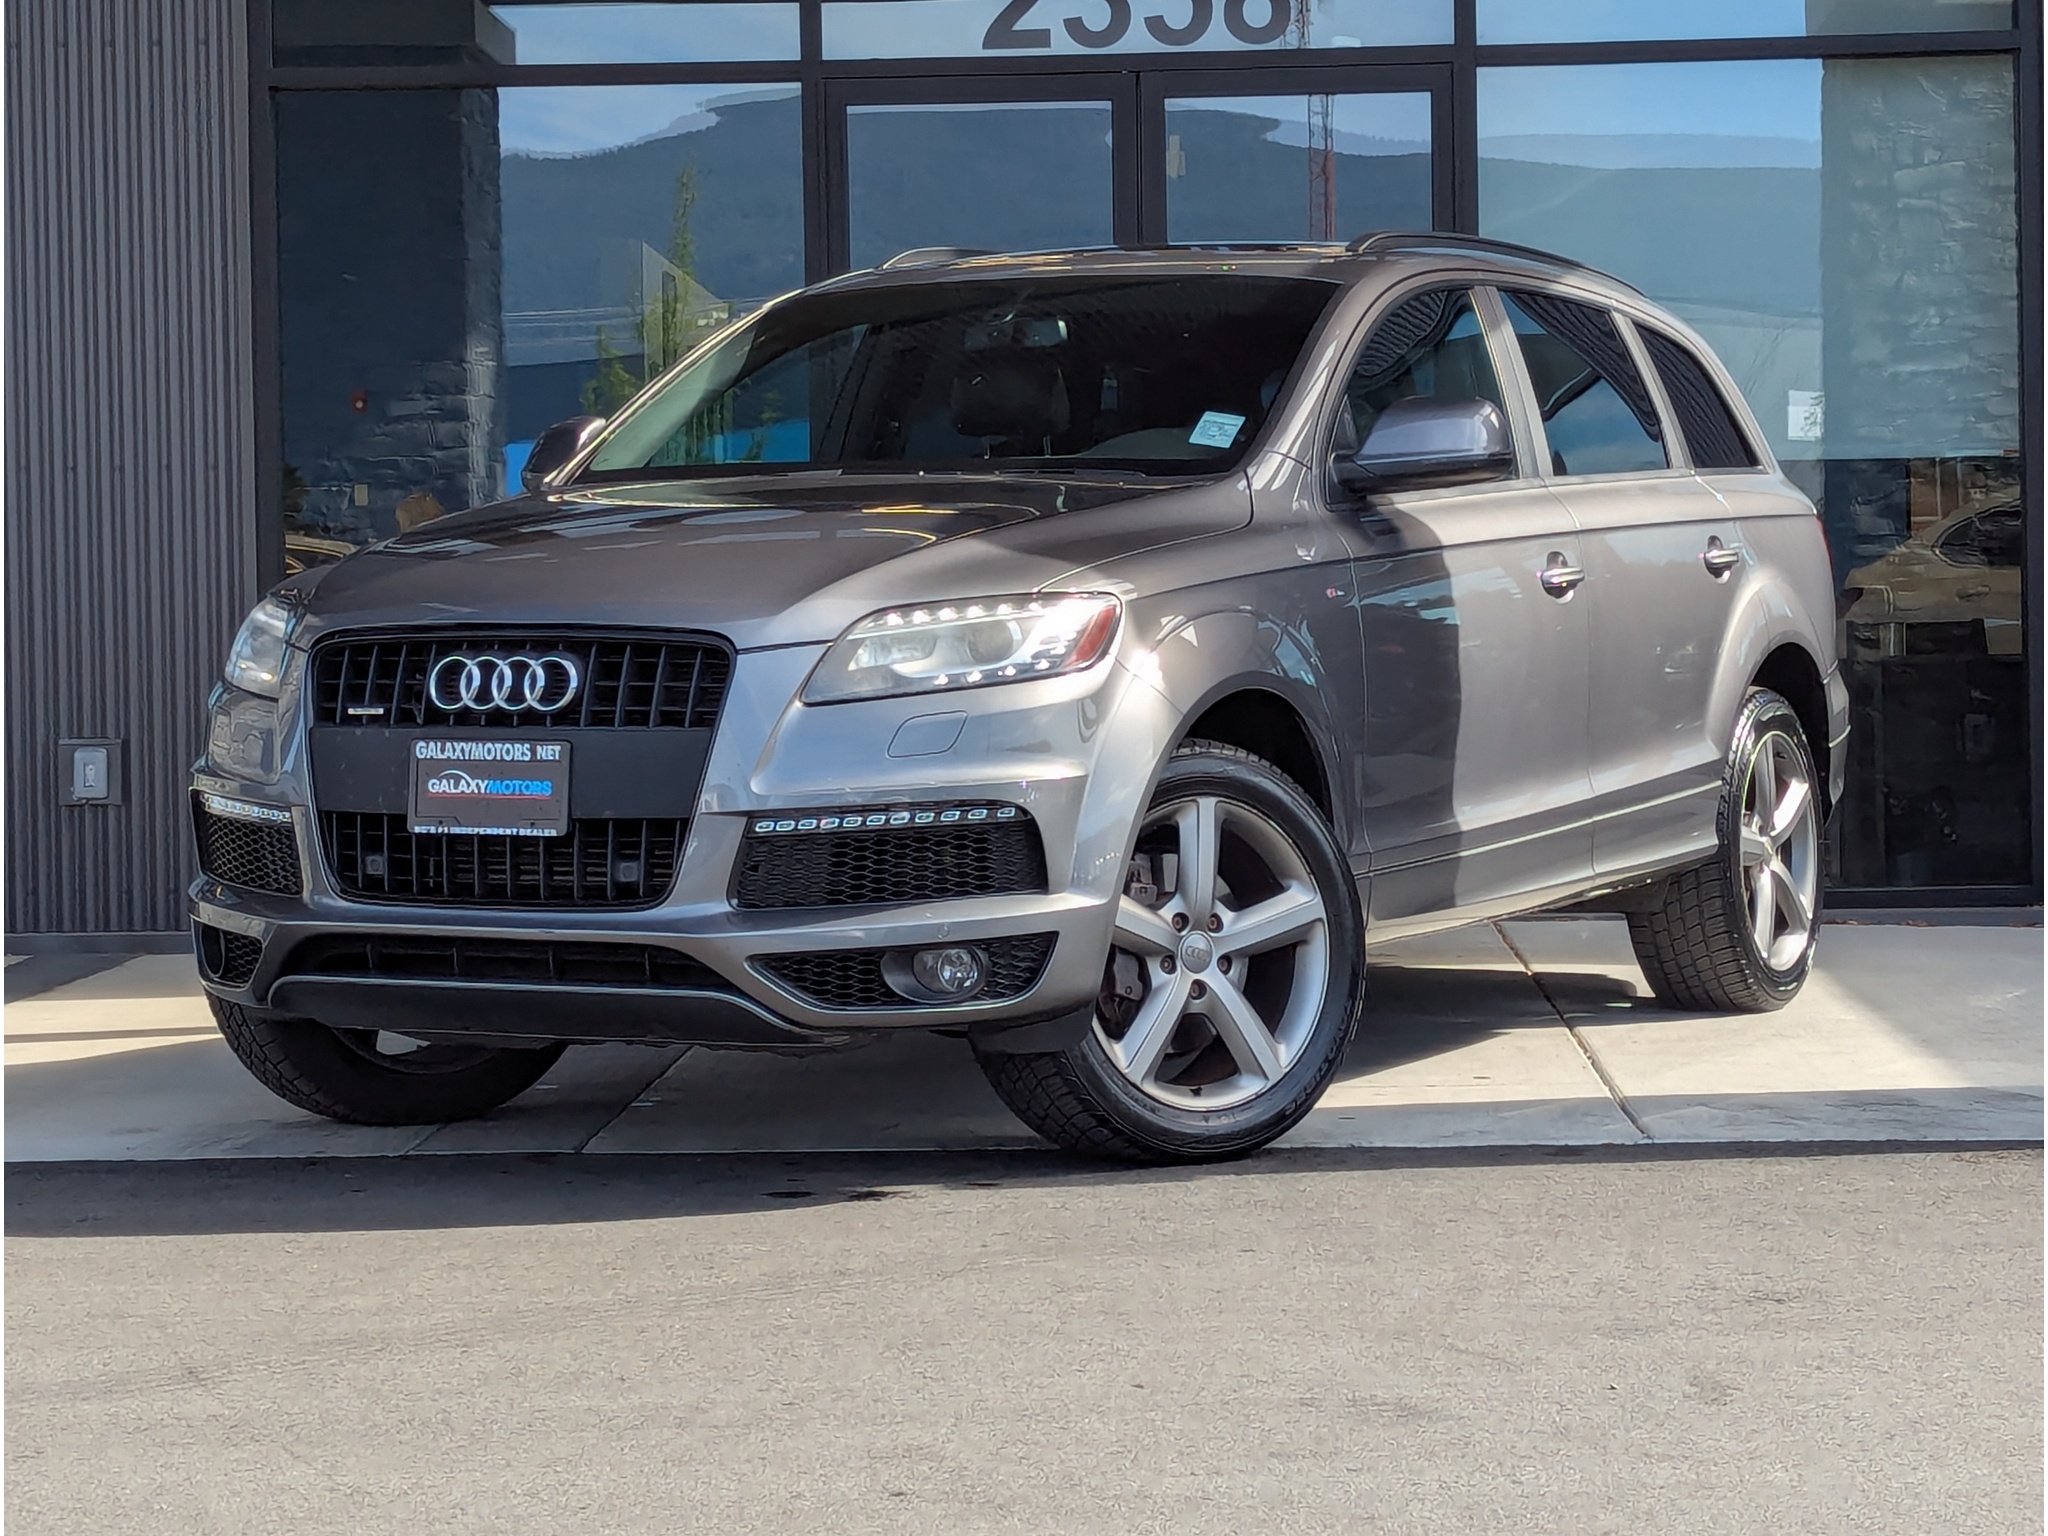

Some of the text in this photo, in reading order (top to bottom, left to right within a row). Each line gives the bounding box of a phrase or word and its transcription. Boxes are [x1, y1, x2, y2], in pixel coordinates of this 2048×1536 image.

[415, 741, 561, 761] GALAXYMOTORS NET
[427, 778, 553, 796] GALAXYMOTORS
